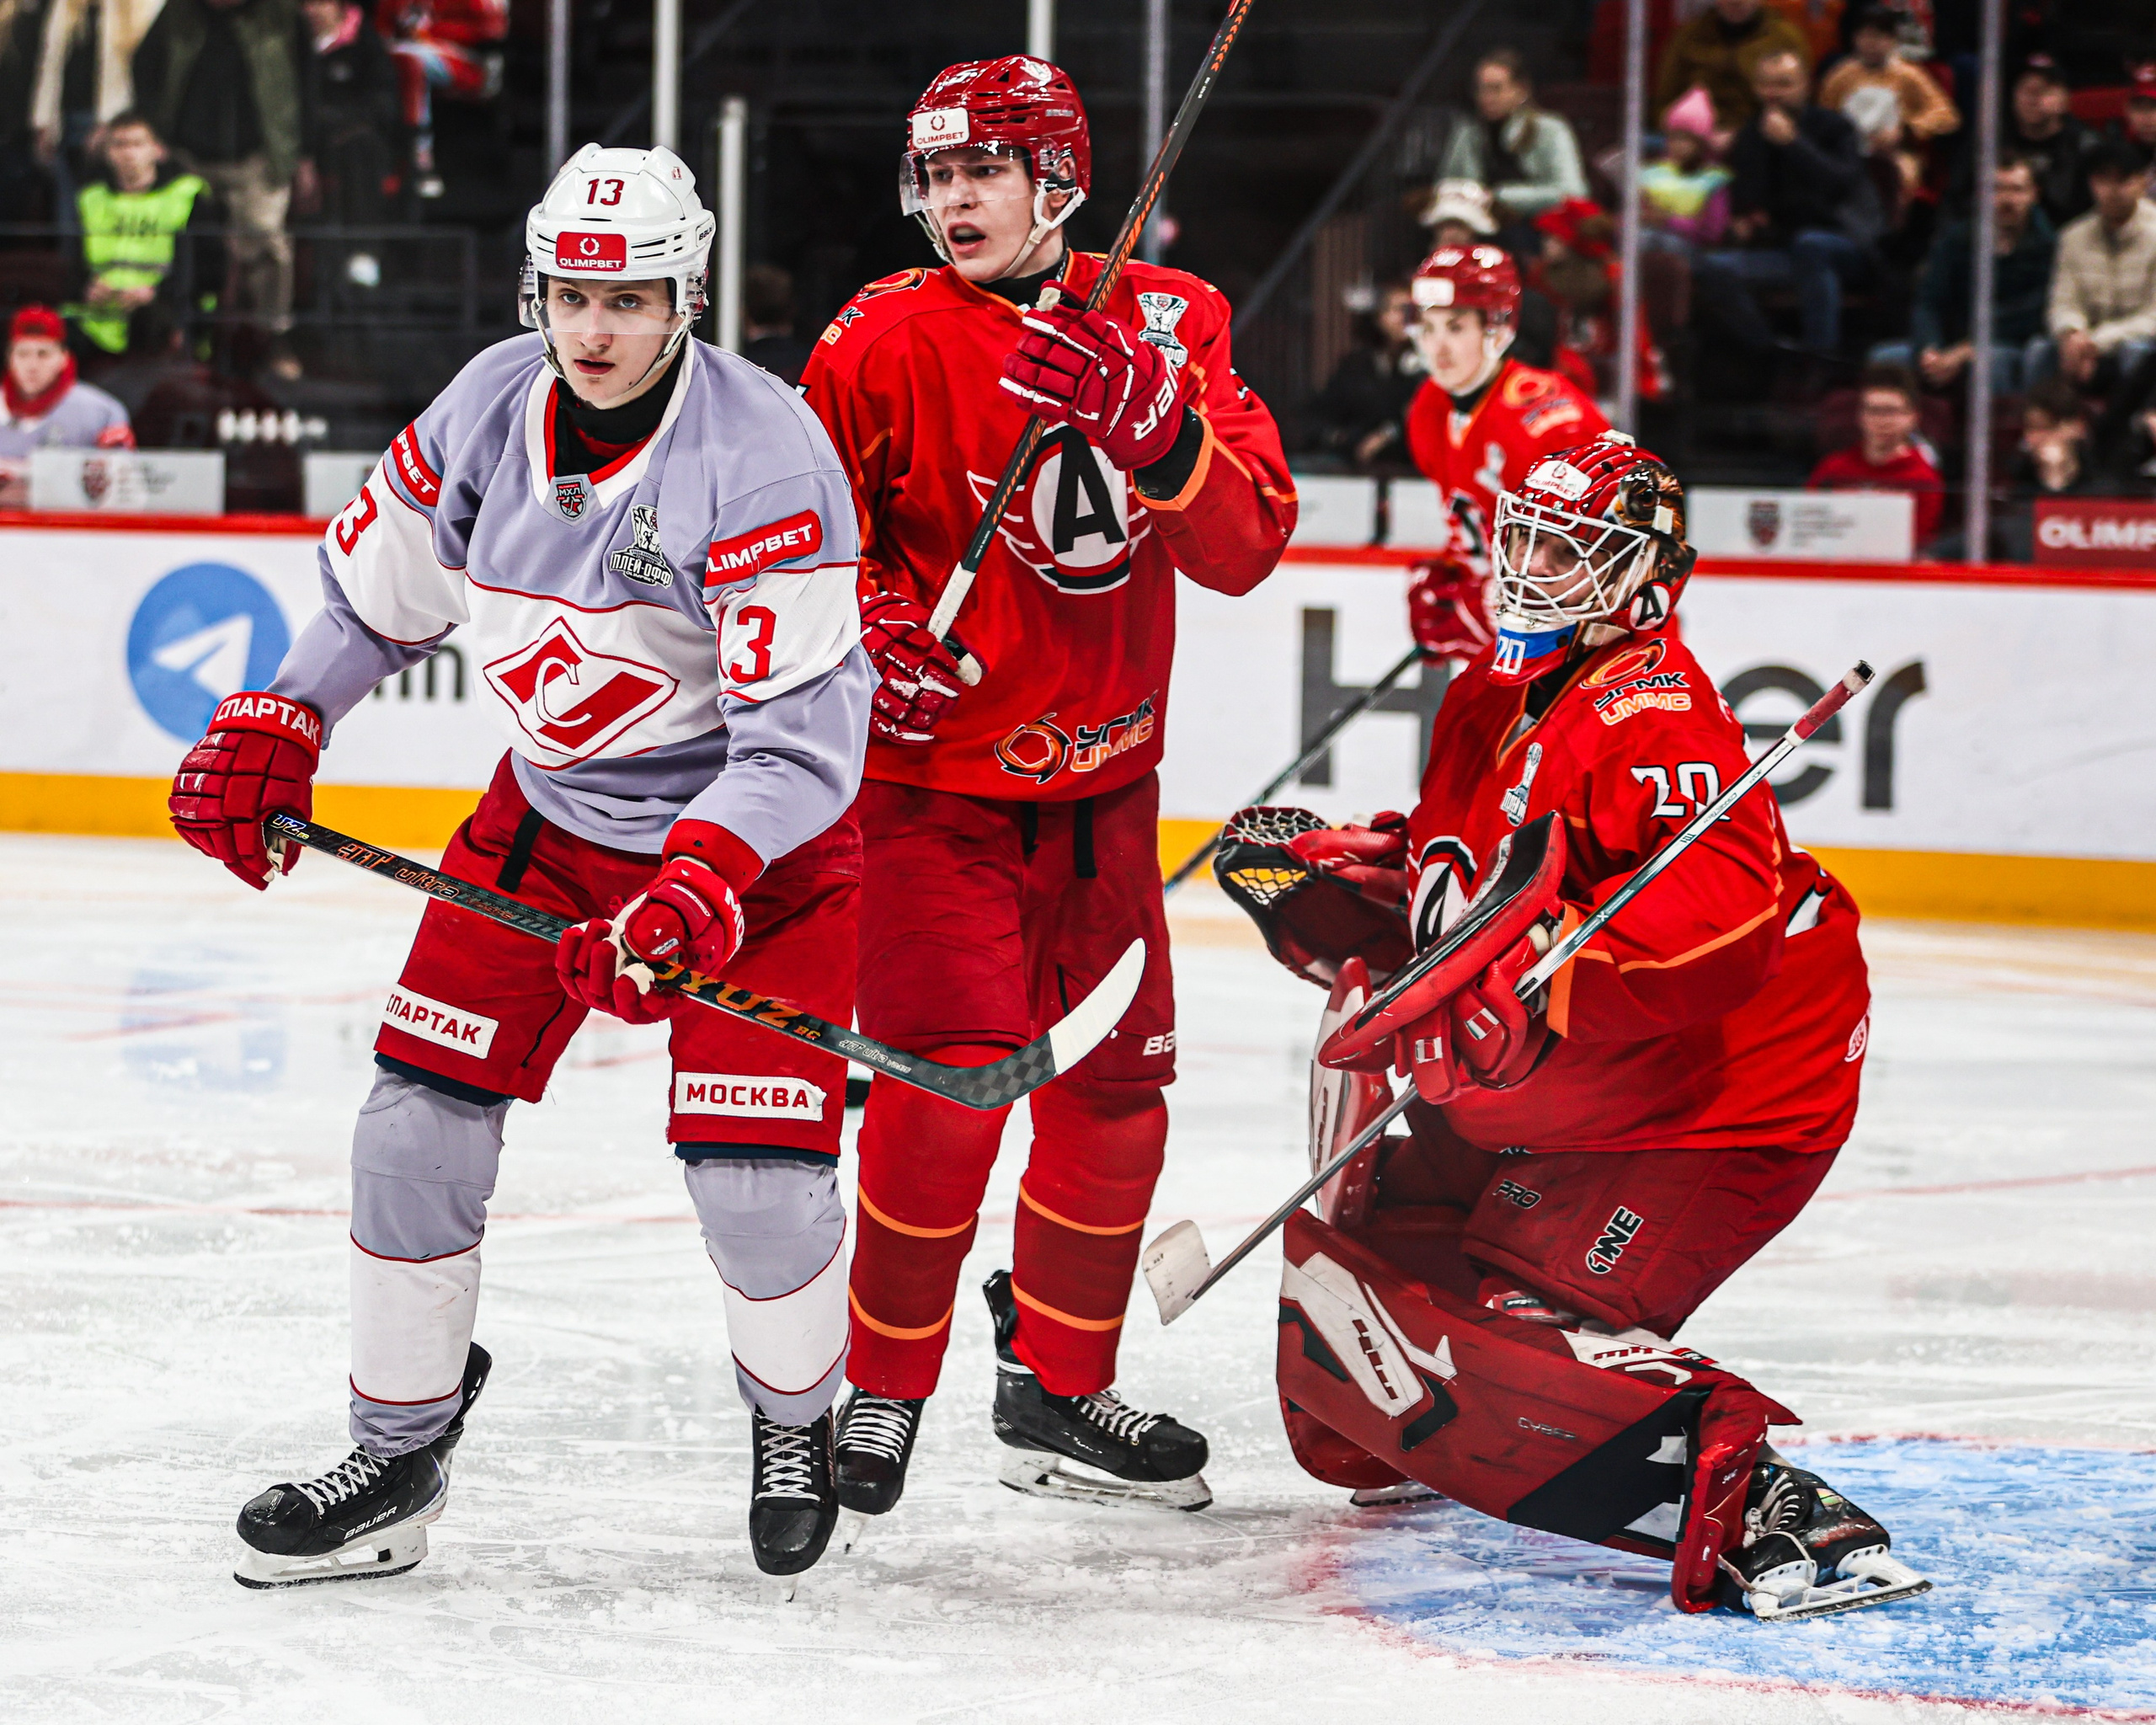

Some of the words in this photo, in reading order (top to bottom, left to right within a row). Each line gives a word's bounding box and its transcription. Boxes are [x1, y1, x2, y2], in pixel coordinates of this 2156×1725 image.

[917, 131, 964, 145] OLIMPBET
[587, 178, 625, 206] 13
[559, 258, 622, 269] OLIMPBET
[397, 428, 437, 494] PBET
[558, 488, 581, 497] МХЛ
[1053, 425, 1127, 556] A
[1529, 478, 1578, 498] OLIMPBET
[706, 523, 813, 573] LIMPBET
[612, 553, 672, 585] ПЛЕЙ-ОФФ
[1635, 590, 1665, 628] A
[1492, 634, 1527, 676] 20
[1594, 672, 1689, 711] УГМК
[1599, 692, 1692, 726] UMMC
[215, 697, 320, 746] СПАРТАК
[1630, 761, 1732, 822] 20
[394, 868, 461, 900] ultra
[654, 960, 804, 1029] OYUZ
[686, 1082, 809, 1108] МОСКВА
[1492, 1178, 1542, 1210] PRO
[344, 1505, 398, 1541] BAUER
